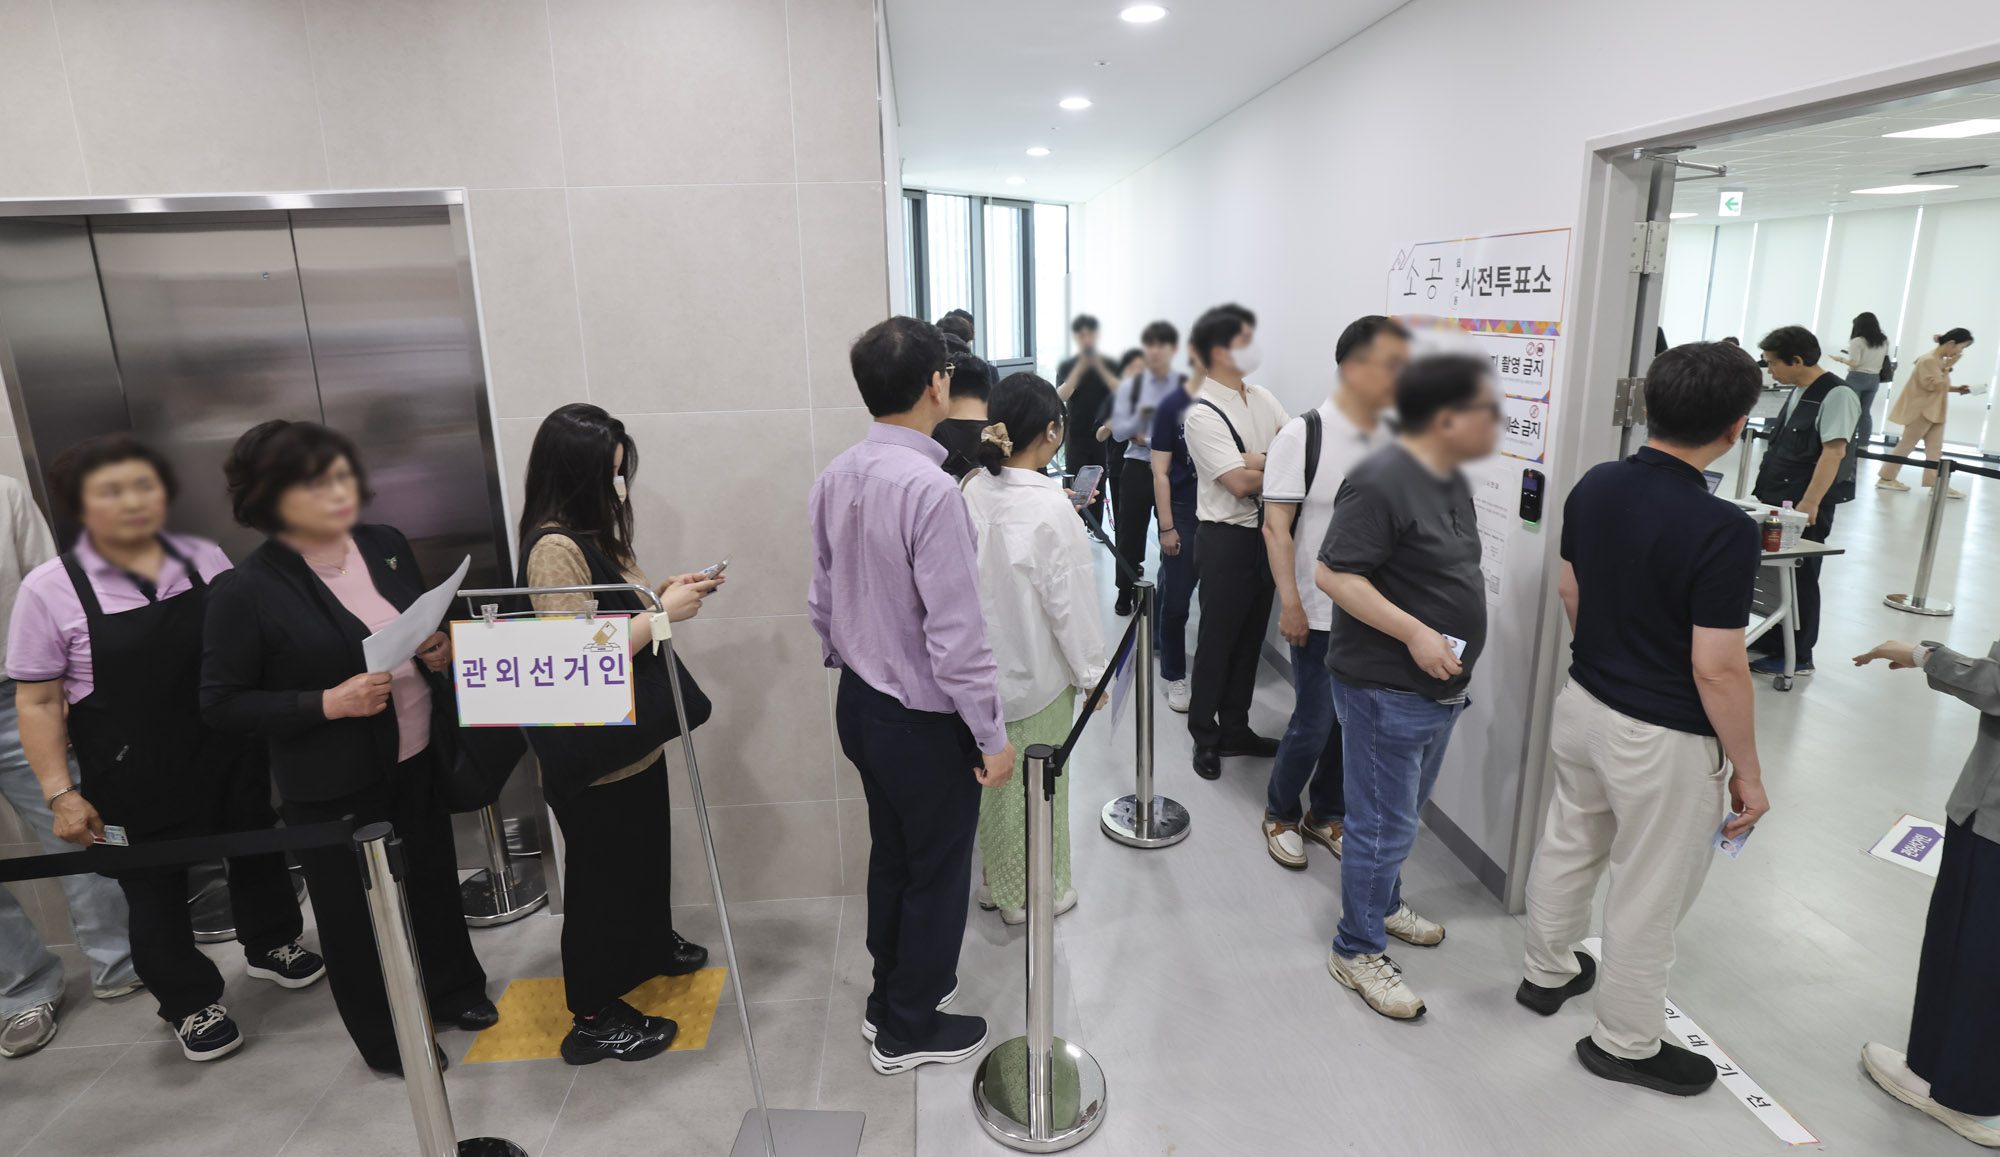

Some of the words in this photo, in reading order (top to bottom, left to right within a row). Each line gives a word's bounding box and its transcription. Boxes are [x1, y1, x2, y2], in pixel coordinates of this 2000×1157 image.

[1403, 257, 1444, 300] 소공
[1461, 264, 1552, 297] 사전투표소
[1501, 355, 1521, 375] 촬영
[1523, 358, 1544, 378] 금지
[1521, 419, 1541, 440] 금지
[462, 653, 626, 688] 관외선거인
